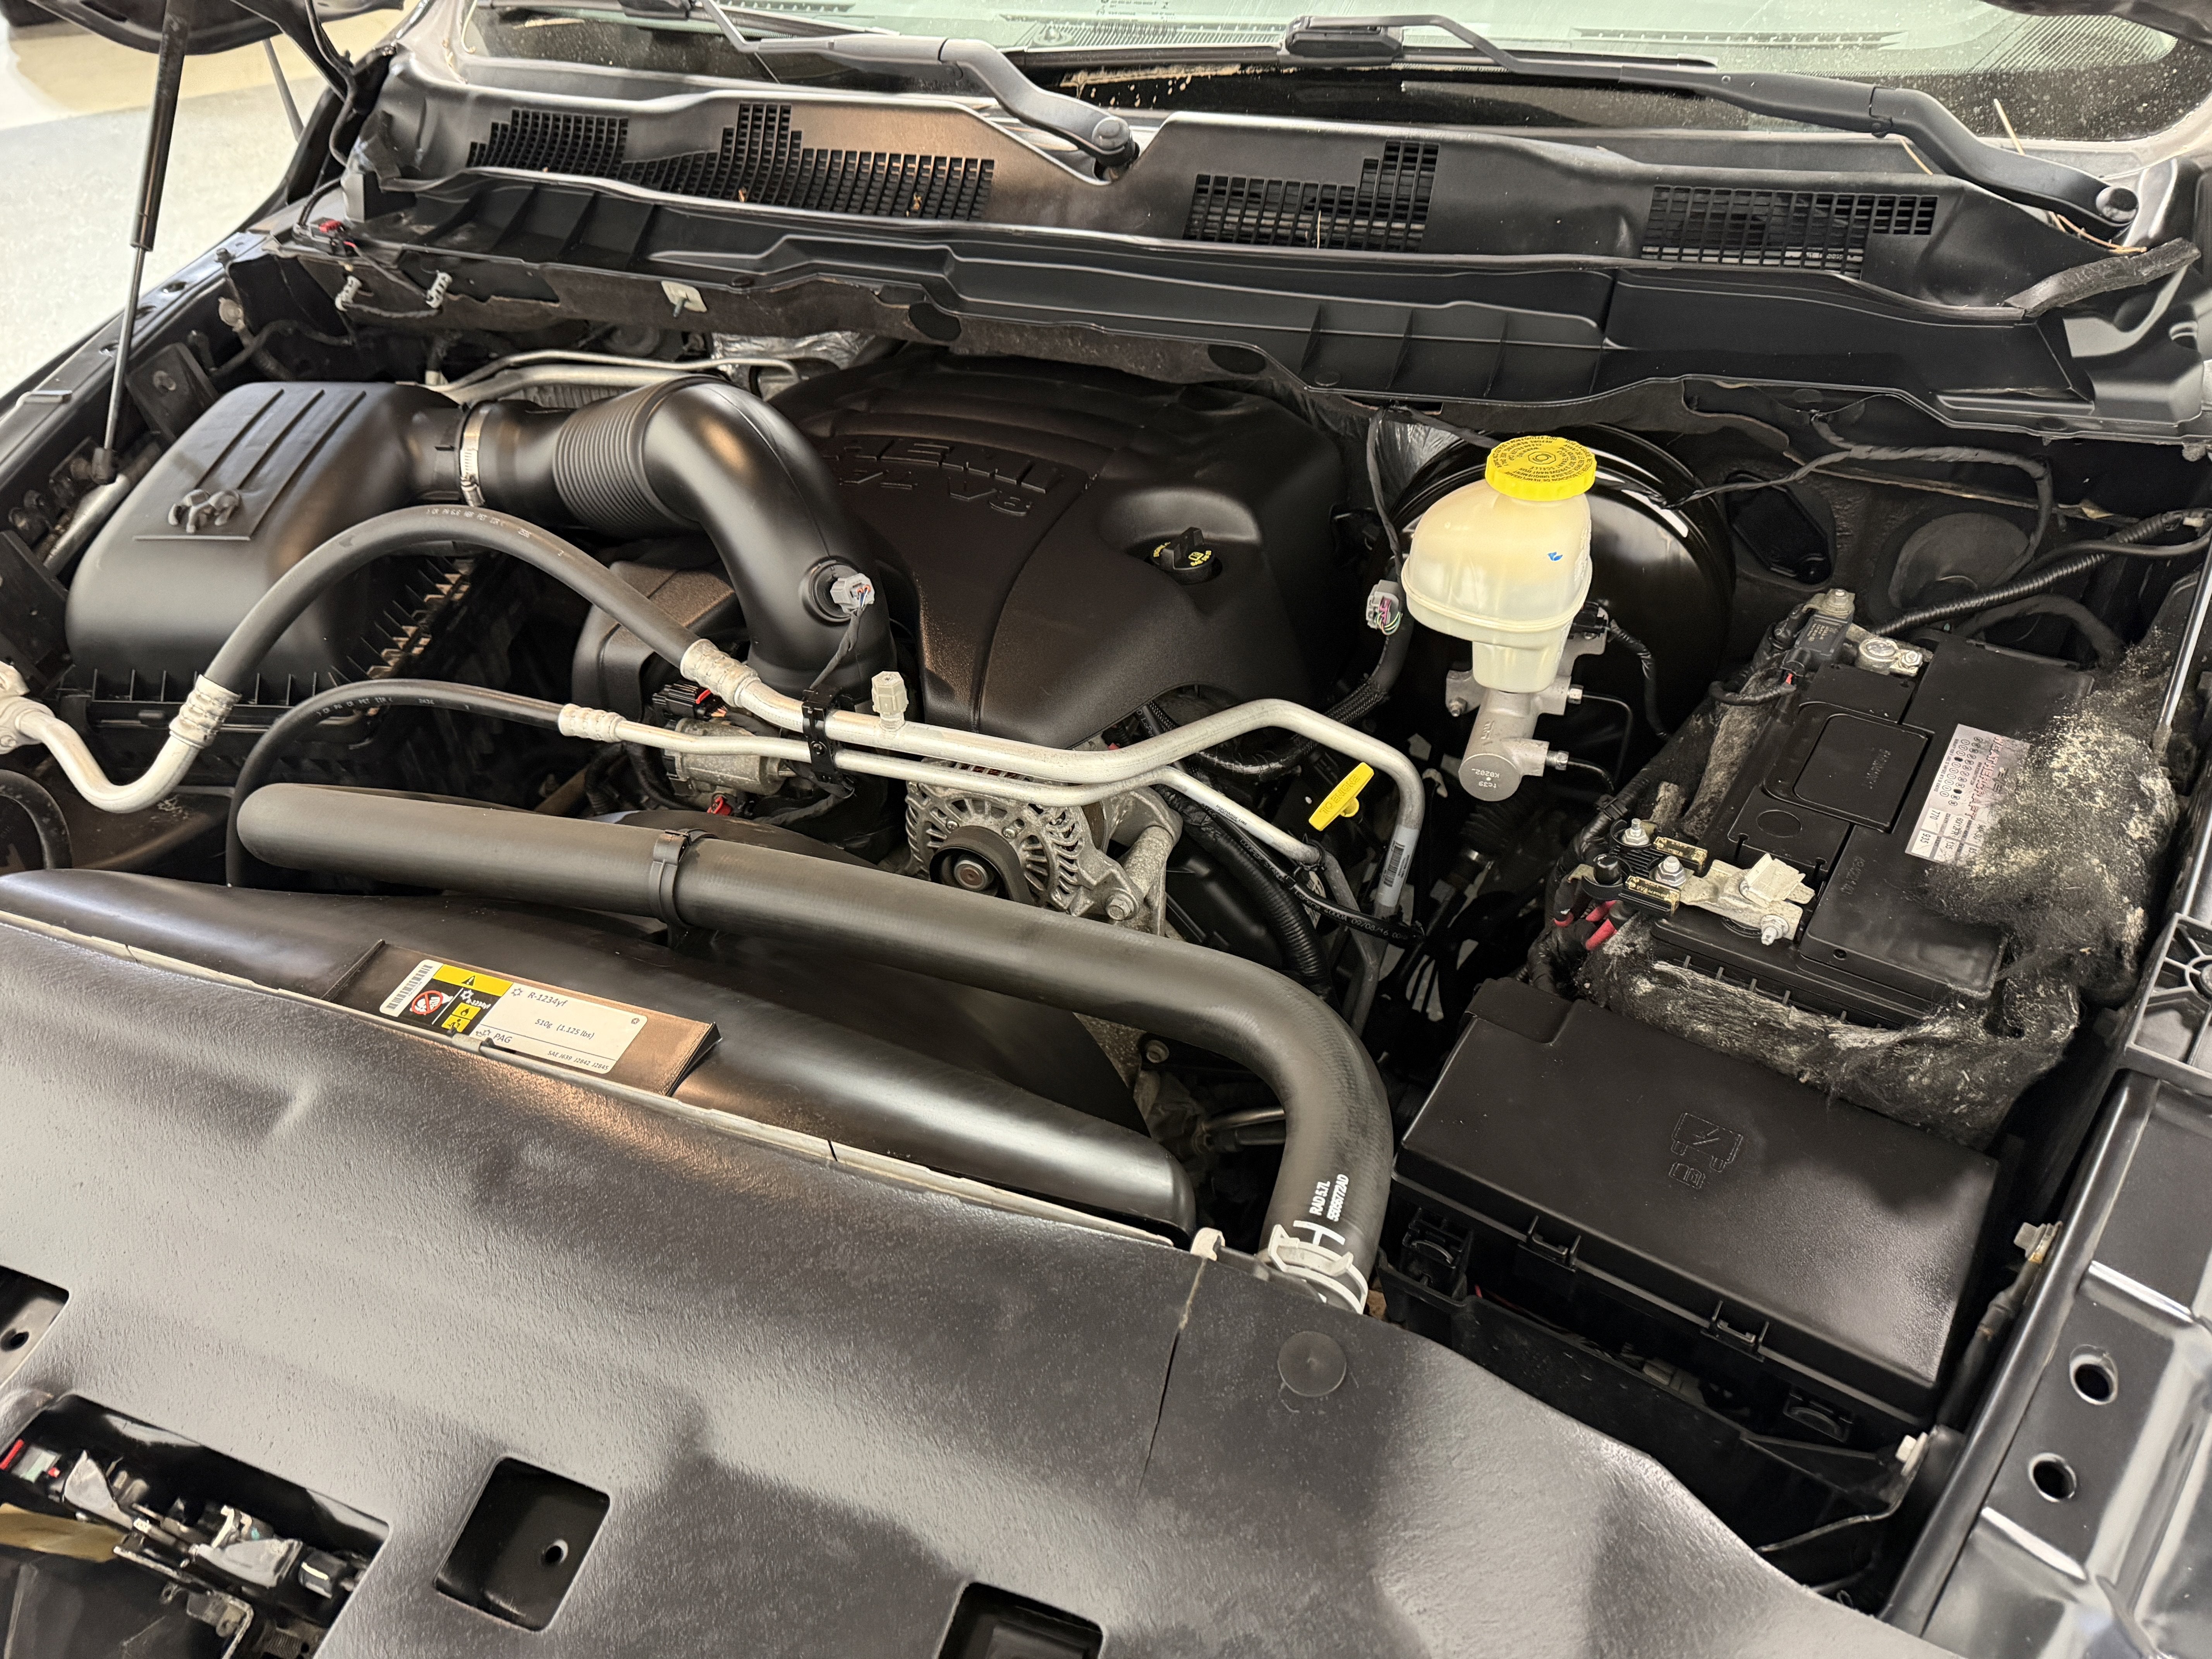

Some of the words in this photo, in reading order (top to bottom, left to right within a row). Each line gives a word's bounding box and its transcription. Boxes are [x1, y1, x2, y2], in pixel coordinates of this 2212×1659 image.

[1965, 736, 2005, 820] WEATHERCRAFT
[1333, 774, 1360, 804] ENGINE
[1319, 800, 1336, 815] OIL
[1930, 810, 1941, 820] 770
[1920, 833, 1931, 844] 935
[527, 991, 568, 1007] R-1234yf
[534, 1018, 553, 1029] 510g
[556, 1023, 578, 1036] (1.125
[579, 1027, 595, 1039] lbs)
[494, 1032, 511, 1044] PAG
[548, 1049, 558, 1058] SAE
[559, 1051, 573, 1061] J639
[573, 1054, 591, 1066] J2842
[591, 1060, 609, 1071] J2845
[1317, 1180, 1331, 1197] 5.7L
[1309, 1195, 1326, 1216] RAD
